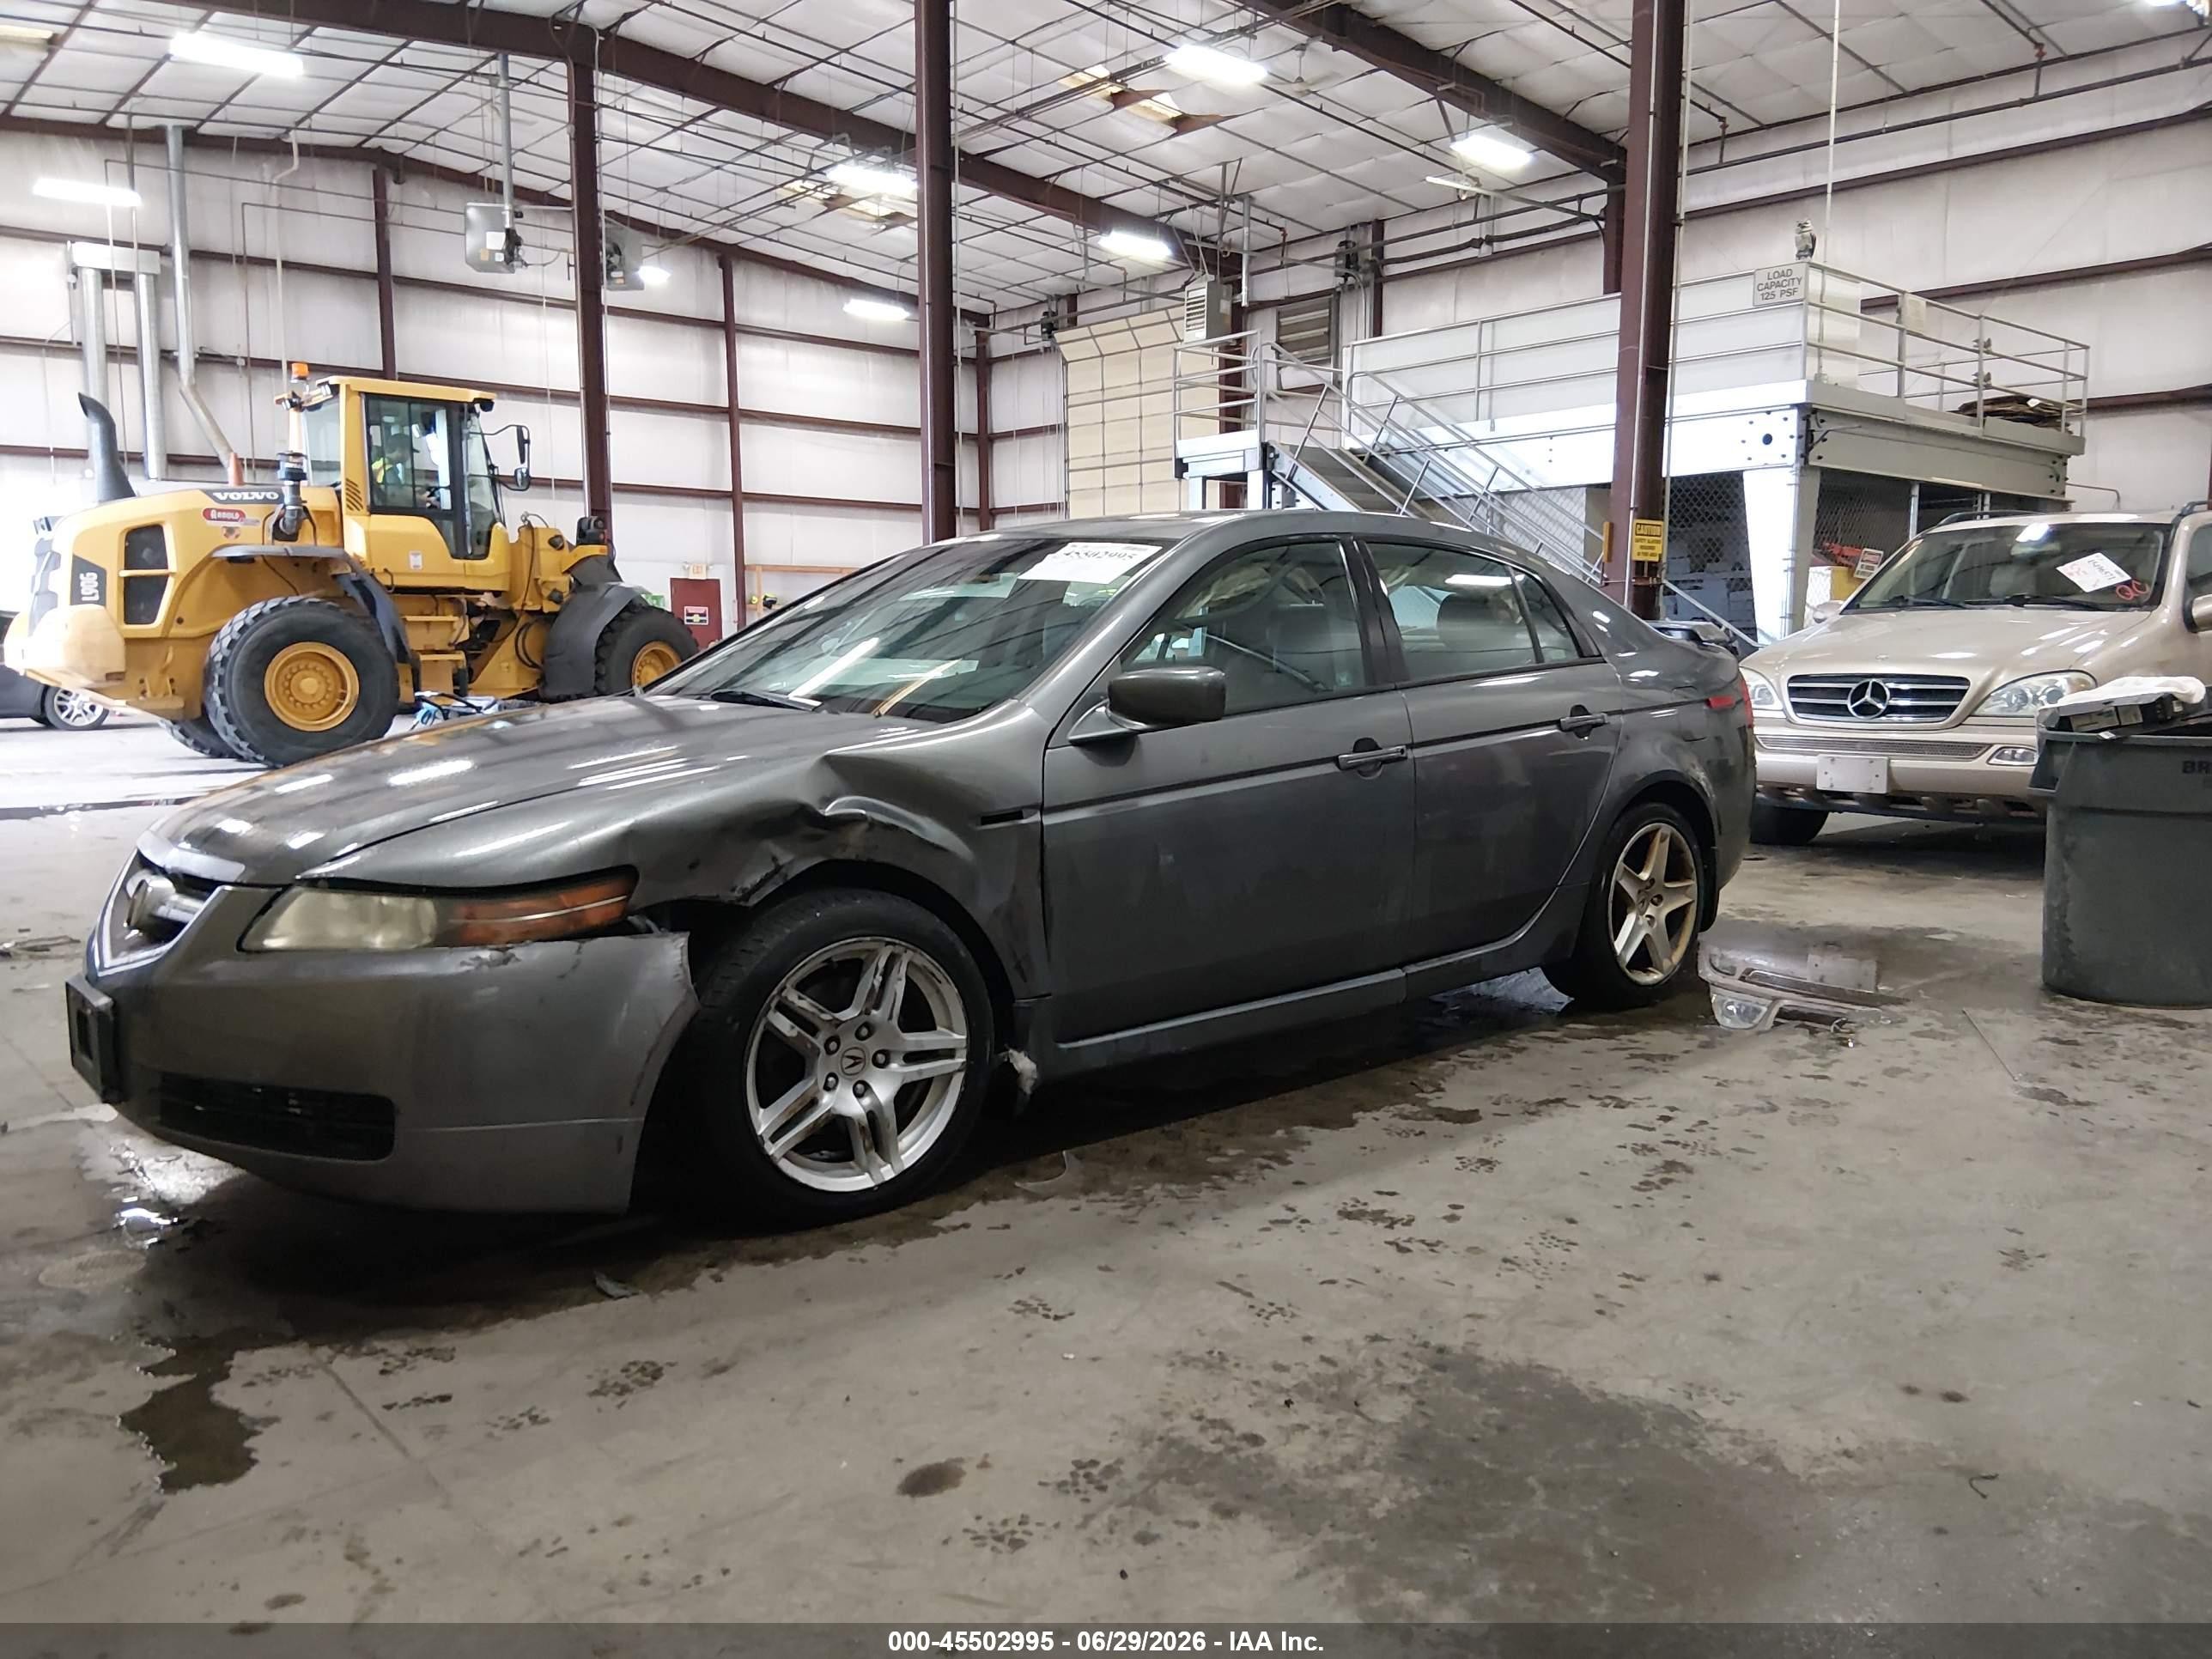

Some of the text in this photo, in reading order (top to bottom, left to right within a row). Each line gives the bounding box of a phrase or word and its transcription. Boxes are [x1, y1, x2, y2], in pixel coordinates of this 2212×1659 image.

[1767, 268, 1793, 280] LOAD
[1757, 276, 1802, 292] CAPACITY
[1760, 288, 1799, 301] 125 PSF
[212, 491, 279, 501] VOLVO
[79, 572, 99, 601] L90G
